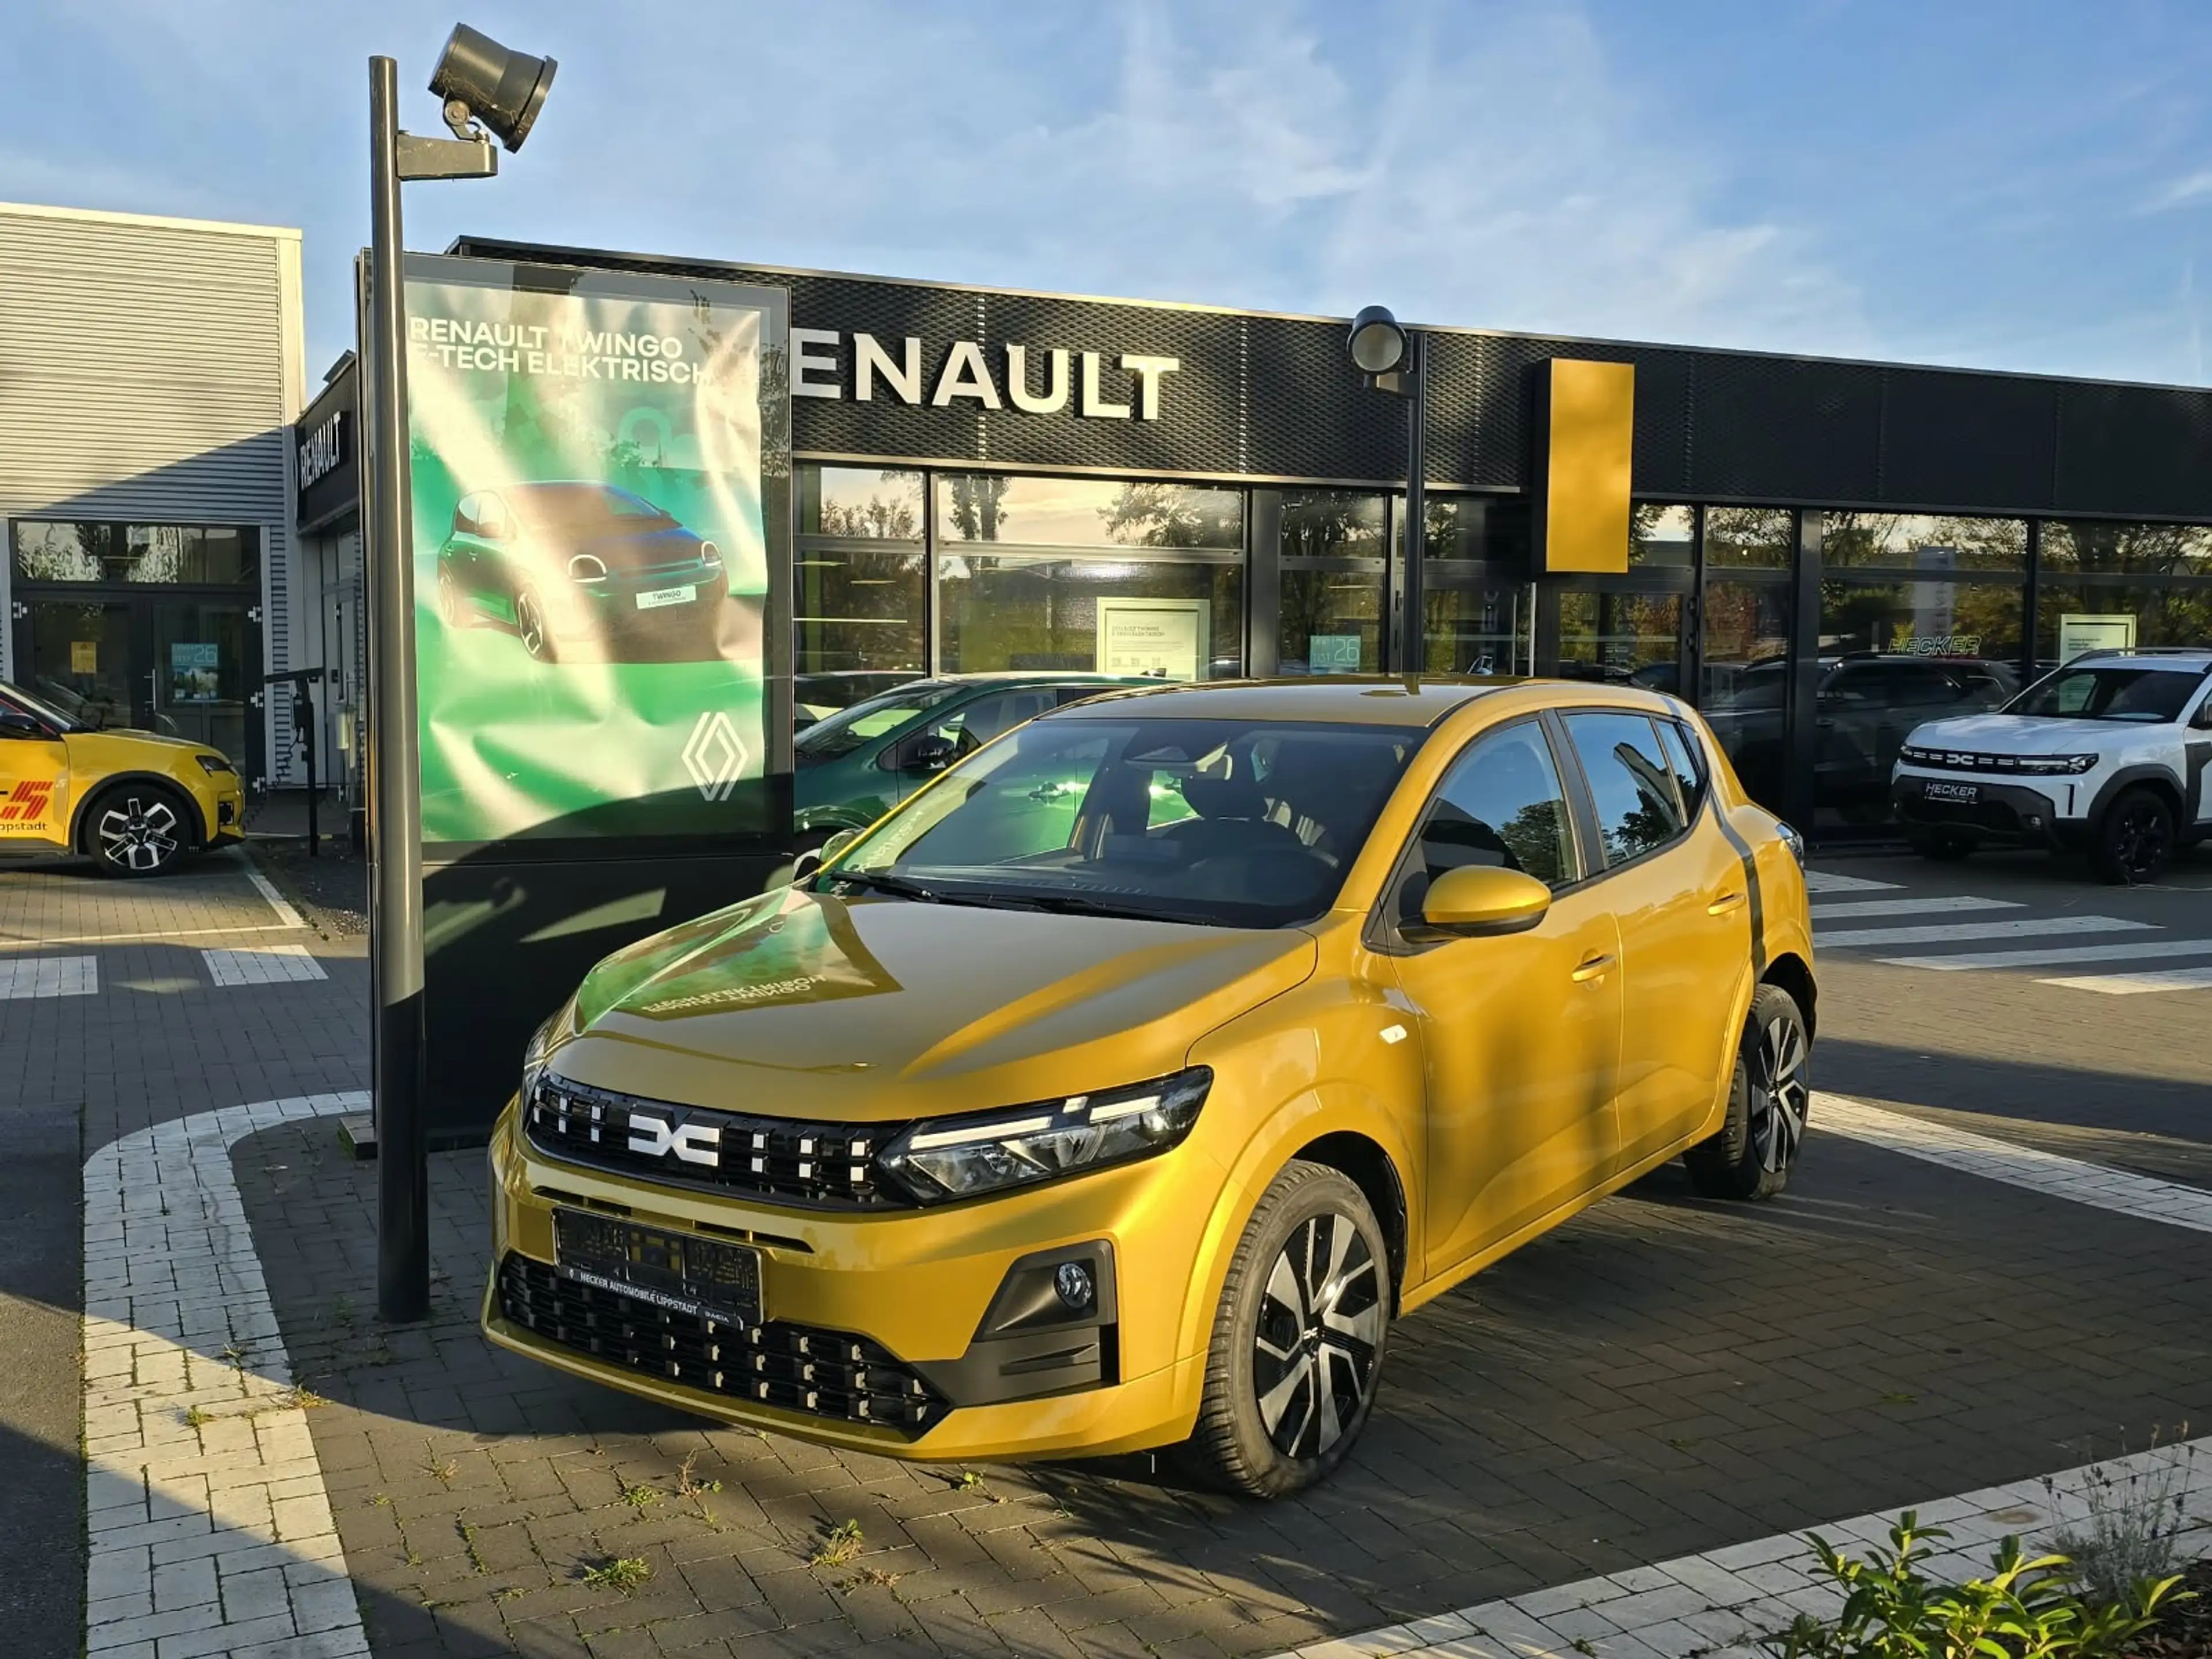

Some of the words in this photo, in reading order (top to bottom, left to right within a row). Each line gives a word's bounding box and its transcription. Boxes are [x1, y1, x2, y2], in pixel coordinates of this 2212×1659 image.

[410, 316, 549, 350] RENAULT
[790, 327, 1180, 421] ENAULT
[300, 410, 341, 491] RENAULT
[1887, 635, 1983, 657] HECKER
[1925, 782, 1978, 797] HECKER
[0, 821, 48, 834] pstadt
[580, 1271, 608, 1288] HECKER
[608, 1281, 656, 1304] AUTOMOBILE
[656, 1294, 698, 1316] LIPPSTADT
